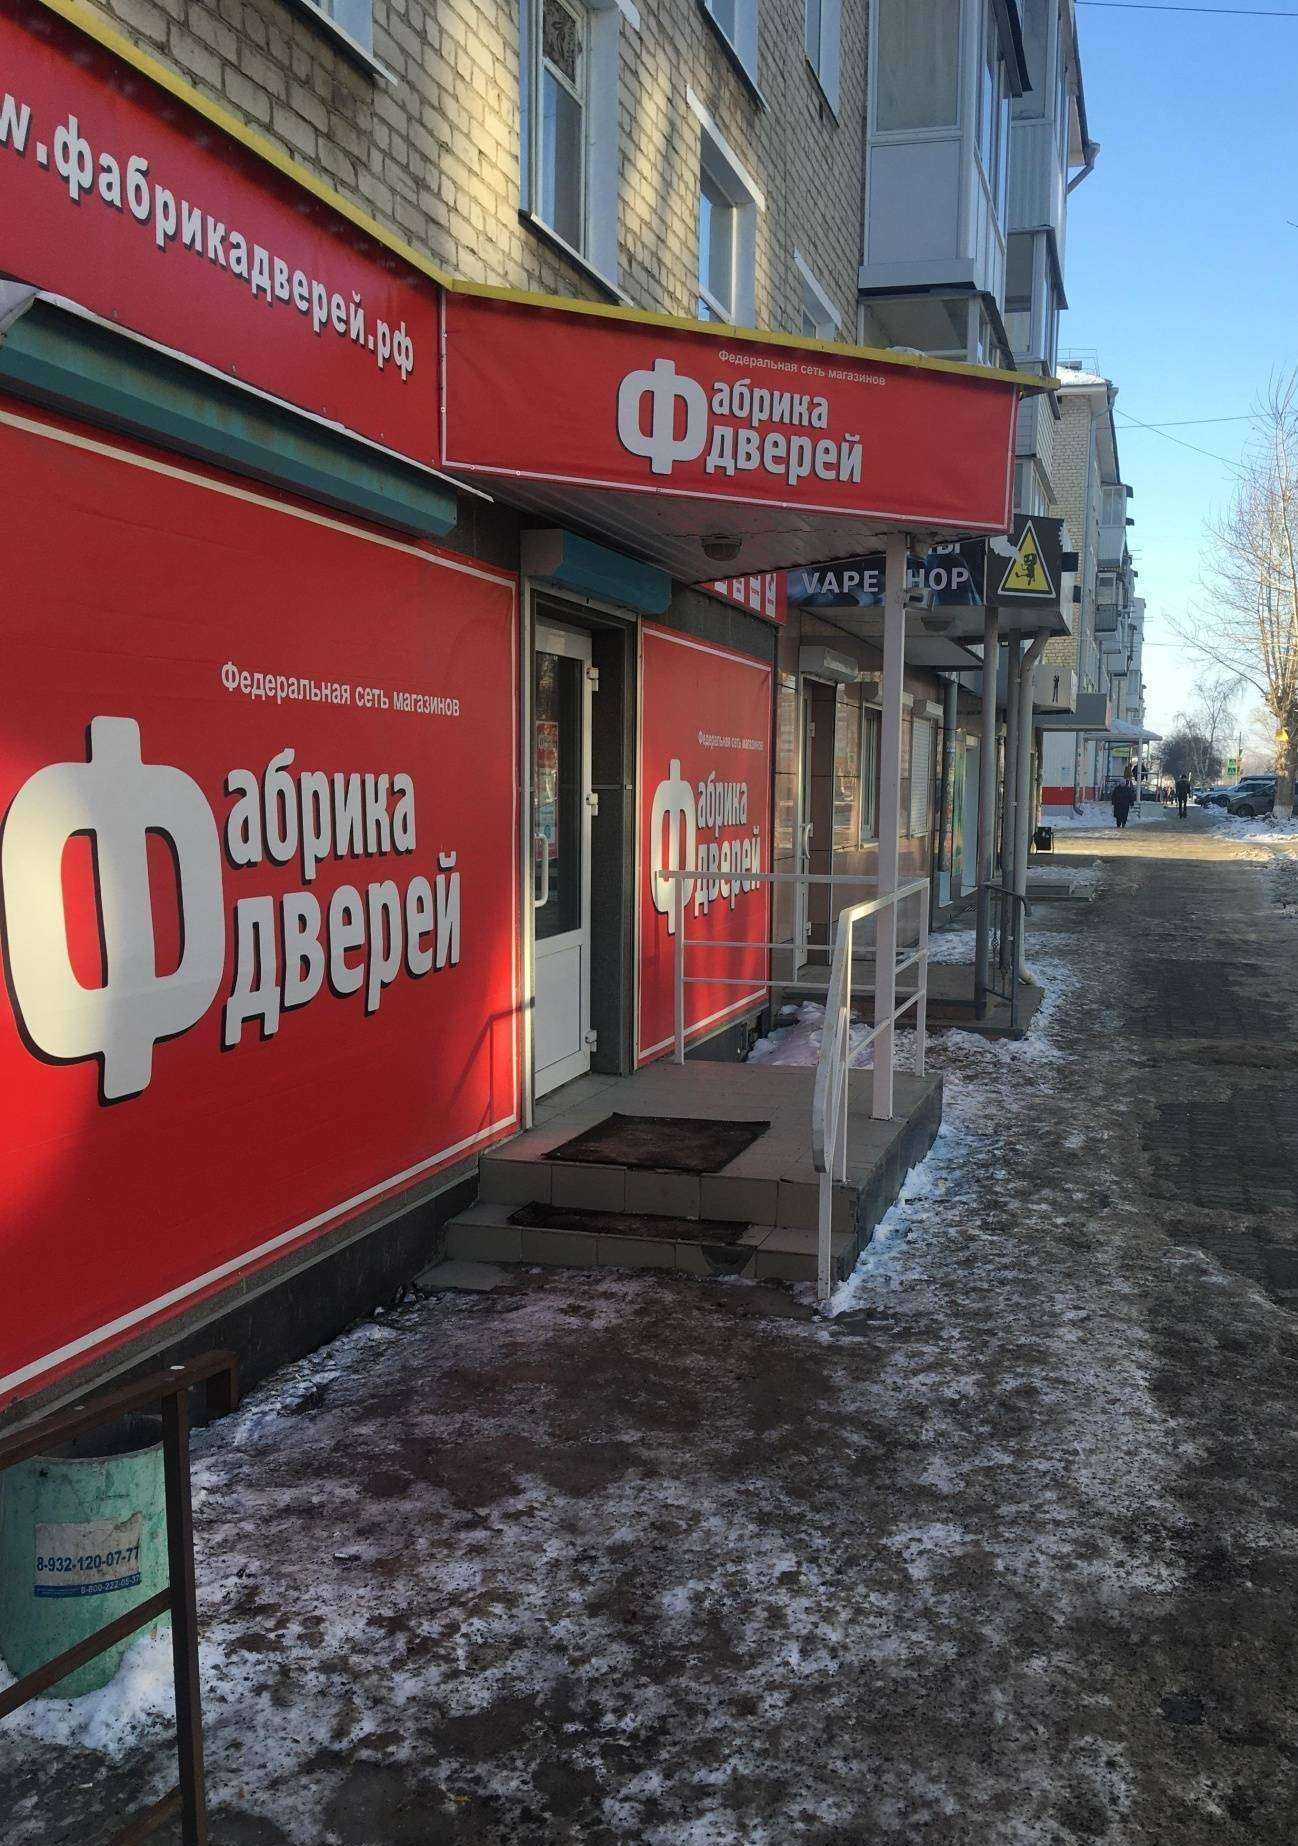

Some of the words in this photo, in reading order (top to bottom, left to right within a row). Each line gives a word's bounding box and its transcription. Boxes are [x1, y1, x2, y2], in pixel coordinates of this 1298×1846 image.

[718, 350, 798, 373] Федеральная
[800, 364, 825, 377] сеть
[828, 369, 887, 386] магазинов
[705, 425, 863, 486] дверей
[801, 570, 879, 594] VAPE
[905, 567, 969, 591] HOP
[221, 661, 350, 704] Федеральная
[355, 685, 389, 709] сеть
[393, 690, 460, 716] магазинов
[694, 826, 761, 918] дверей
[223, 851, 461, 1048] дверей
